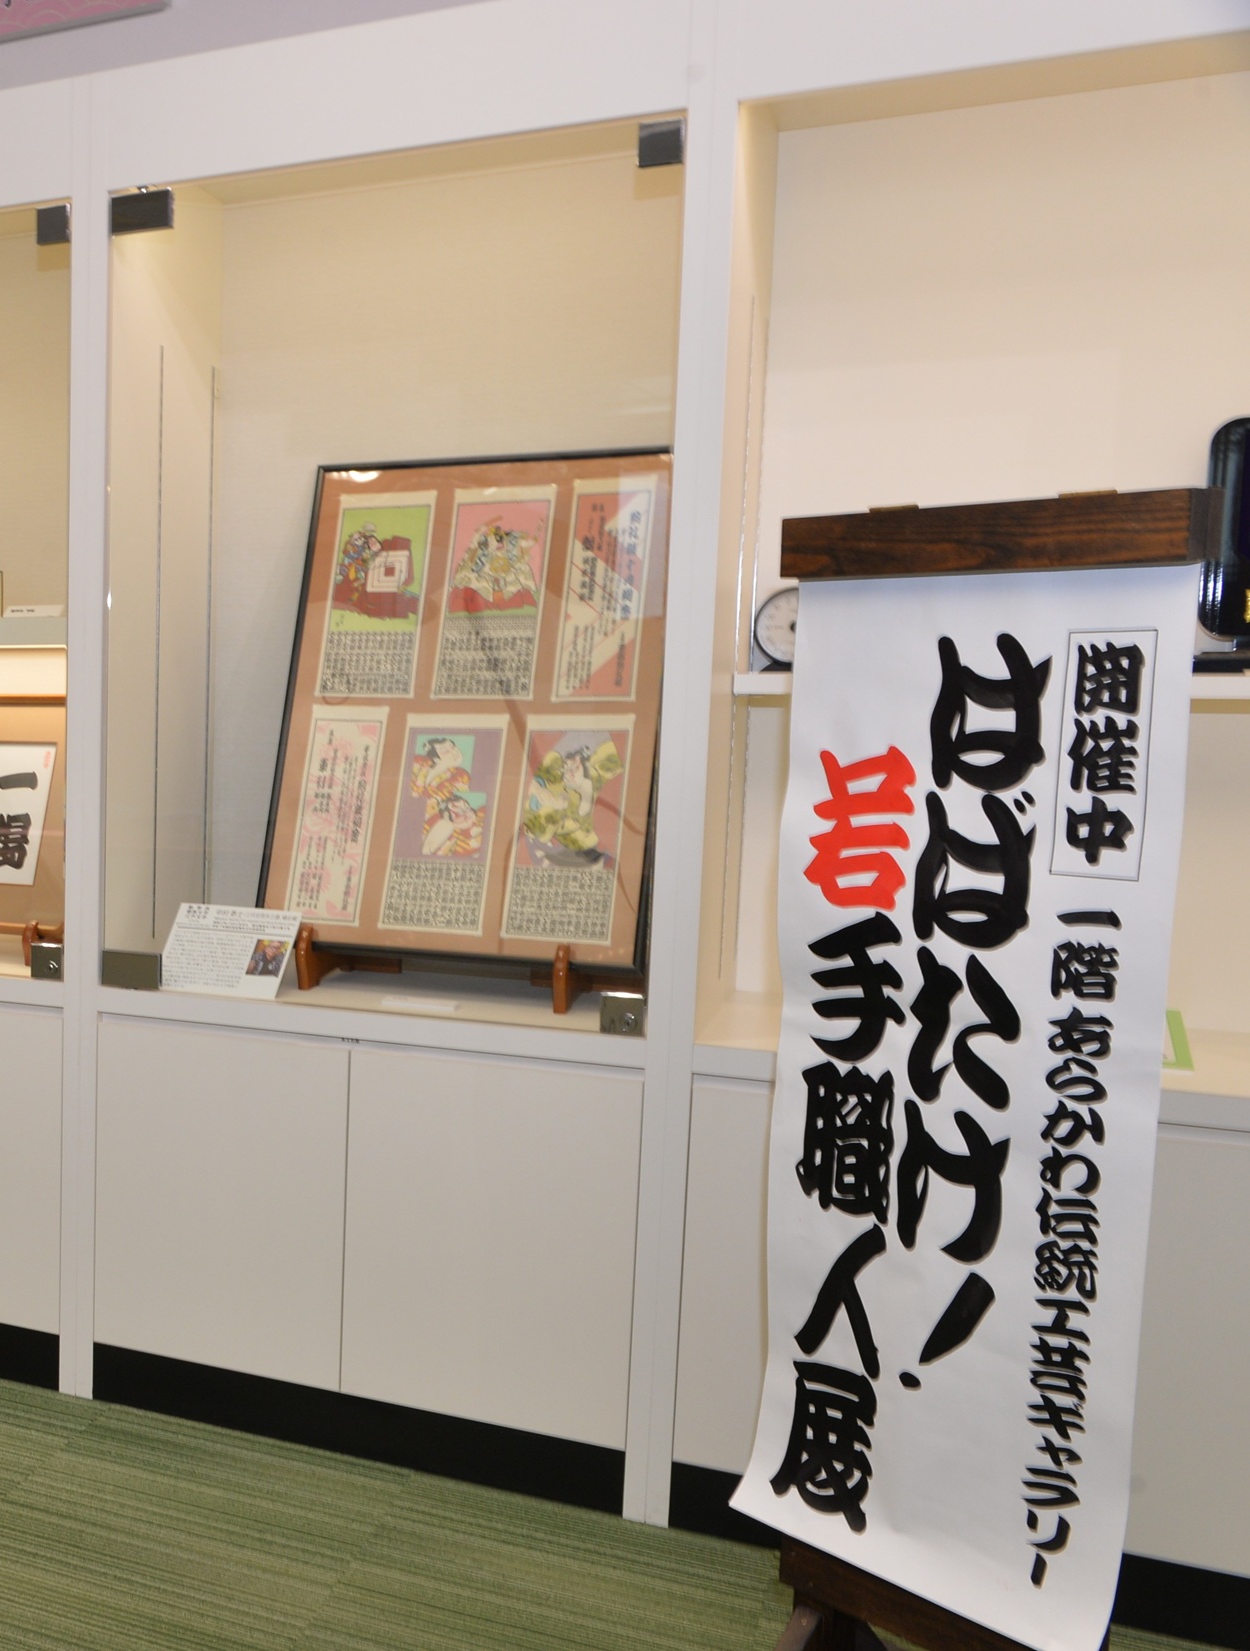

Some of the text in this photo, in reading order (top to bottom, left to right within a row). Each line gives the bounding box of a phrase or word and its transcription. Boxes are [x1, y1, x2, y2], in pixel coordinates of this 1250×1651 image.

[1066, 641, 1144, 865] 開催中
[769, 745, 917, 1534] 若手職人展
